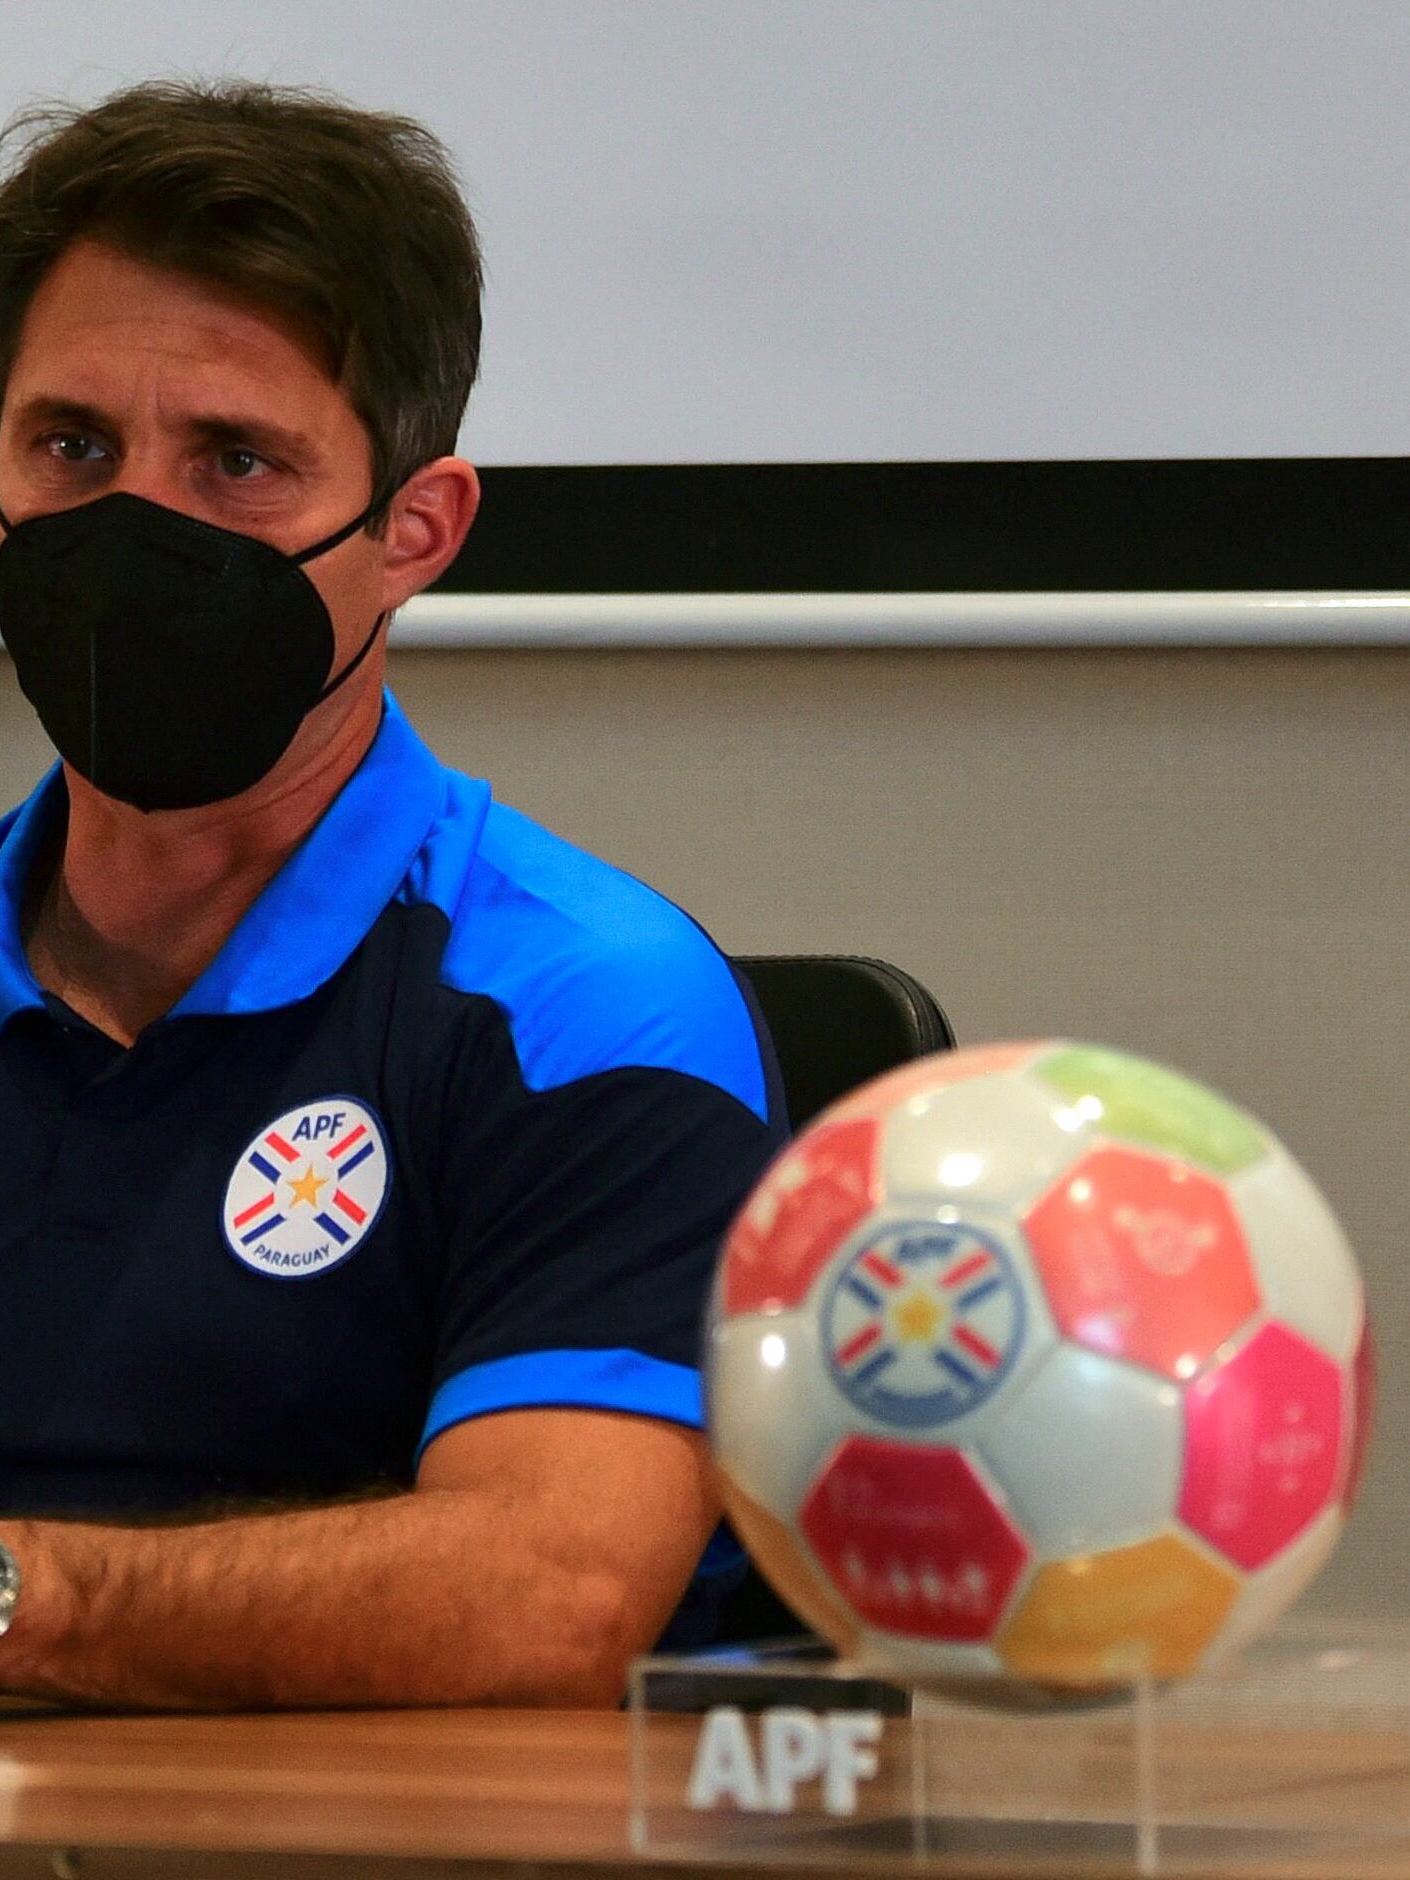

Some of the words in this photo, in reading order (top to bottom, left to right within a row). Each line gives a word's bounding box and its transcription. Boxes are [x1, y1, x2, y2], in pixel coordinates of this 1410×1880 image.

[291, 1113, 346, 1141] APF
[253, 1244, 331, 1267] PARAGUAY
[688, 1706, 883, 1815] APF
